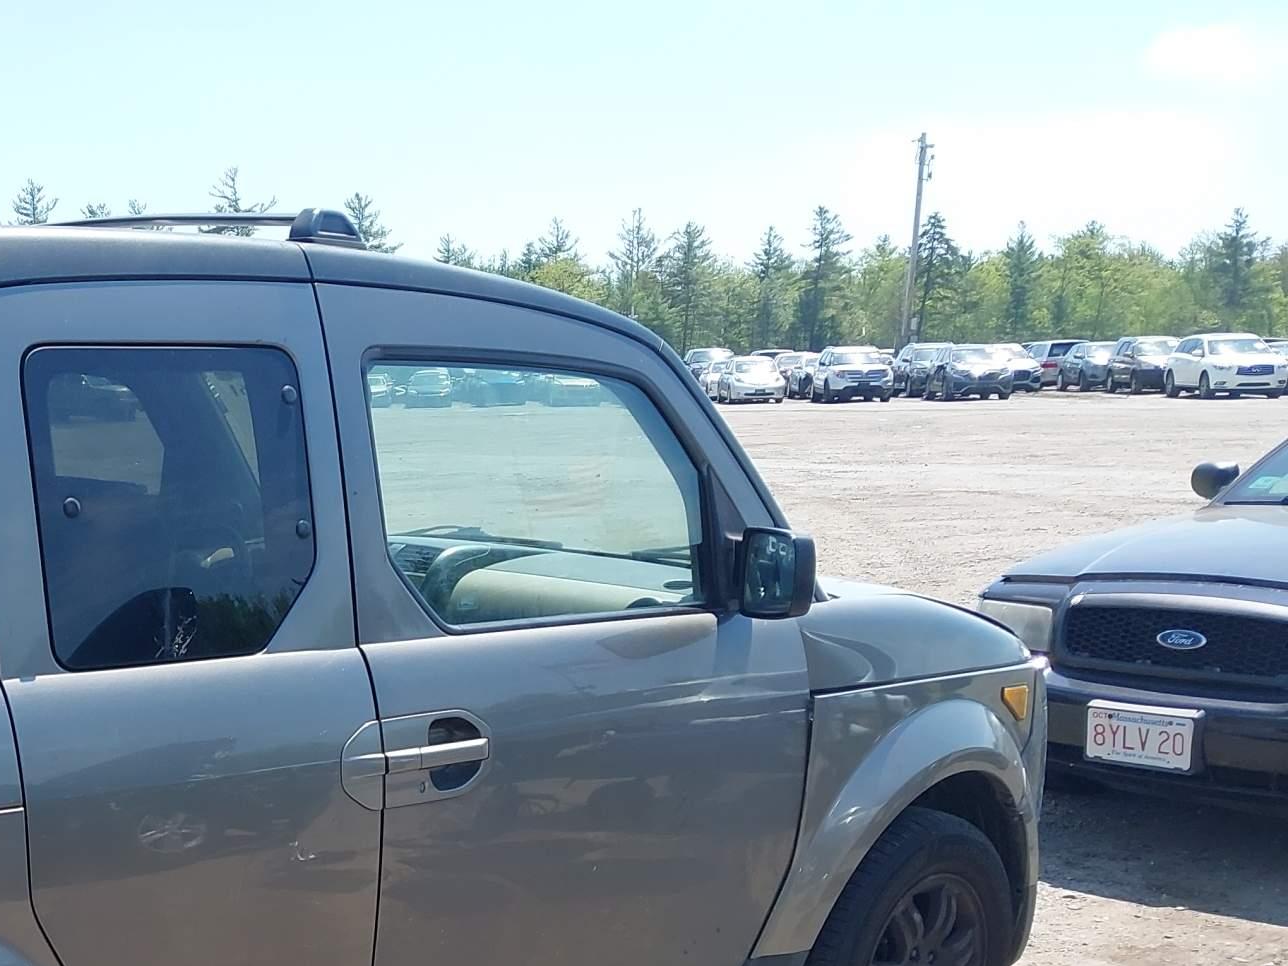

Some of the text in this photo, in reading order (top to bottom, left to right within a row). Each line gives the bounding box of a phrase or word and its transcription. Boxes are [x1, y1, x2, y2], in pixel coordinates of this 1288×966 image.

[1167, 633, 1195, 645] Ford
[1093, 723, 1150, 752] 8YLV
[1157, 730, 1185, 757] 20
